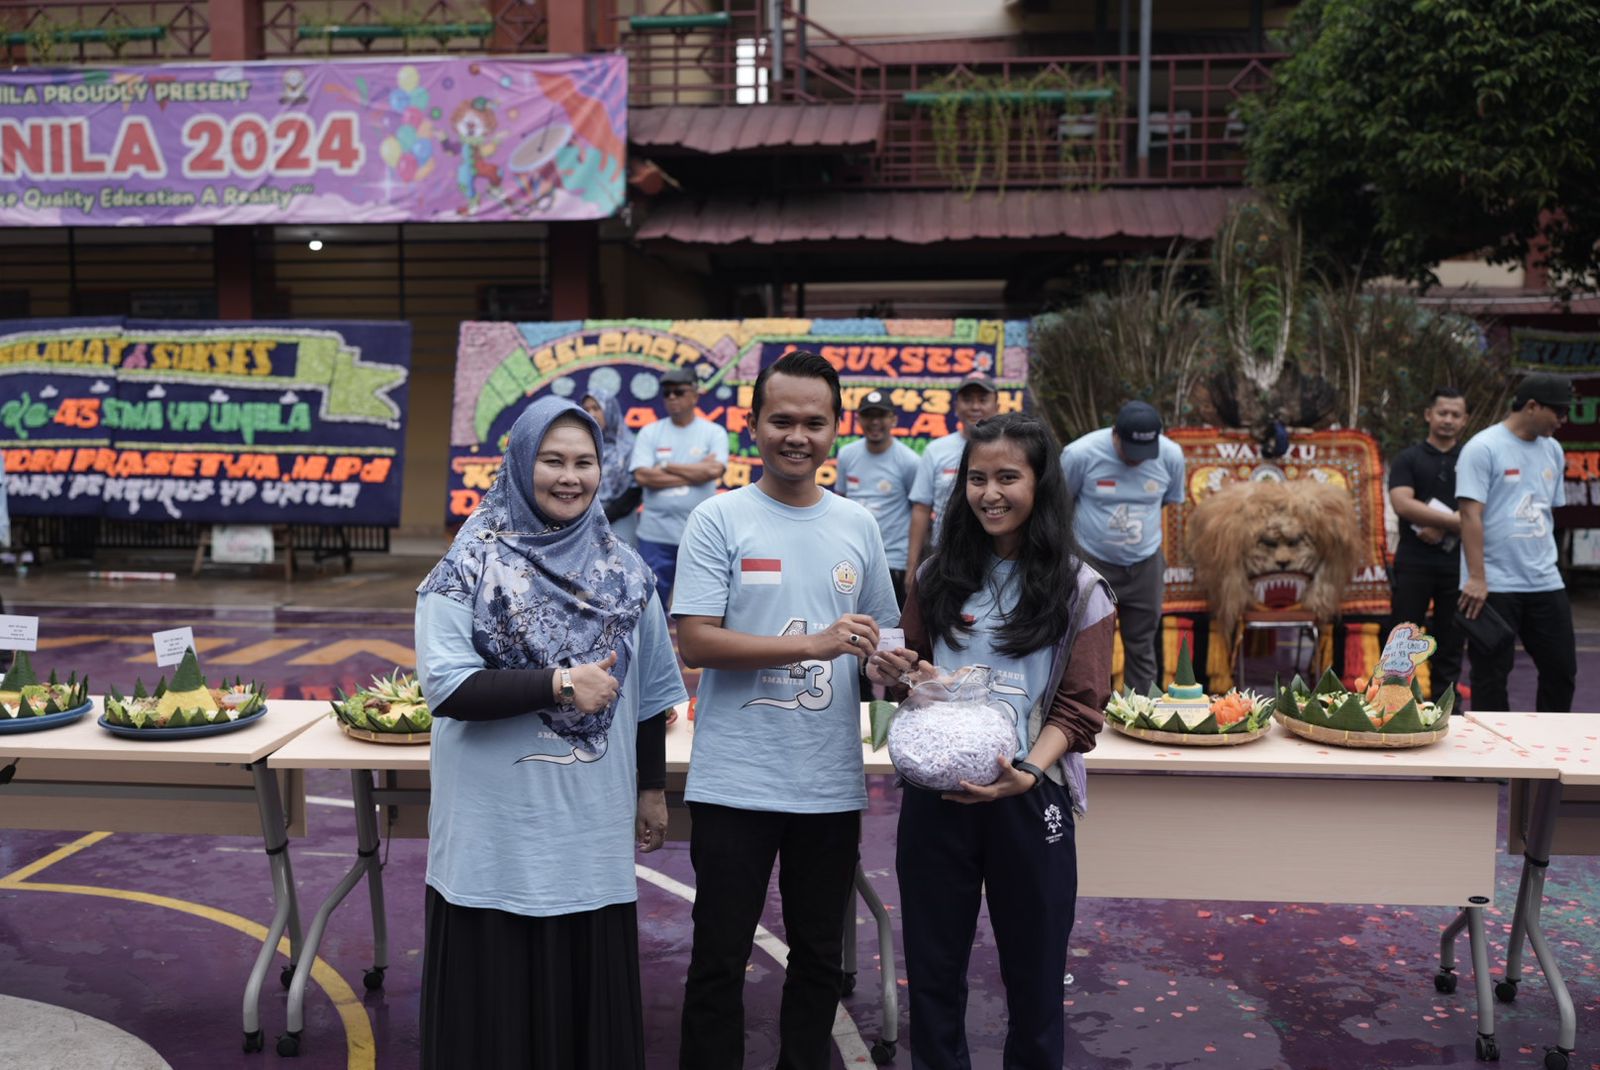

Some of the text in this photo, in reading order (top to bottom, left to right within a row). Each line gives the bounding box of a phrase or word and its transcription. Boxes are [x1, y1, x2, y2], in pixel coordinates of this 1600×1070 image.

[0, 81, 250, 104] ILA PROUDLY PRESENT
[0, 114, 364, 177] NILA 2024
[24, 188, 95, 213] Quality
[101, 188, 195, 207] Education
[201, 188, 218, 206] A
[821, 346, 976, 377] SUKSES
